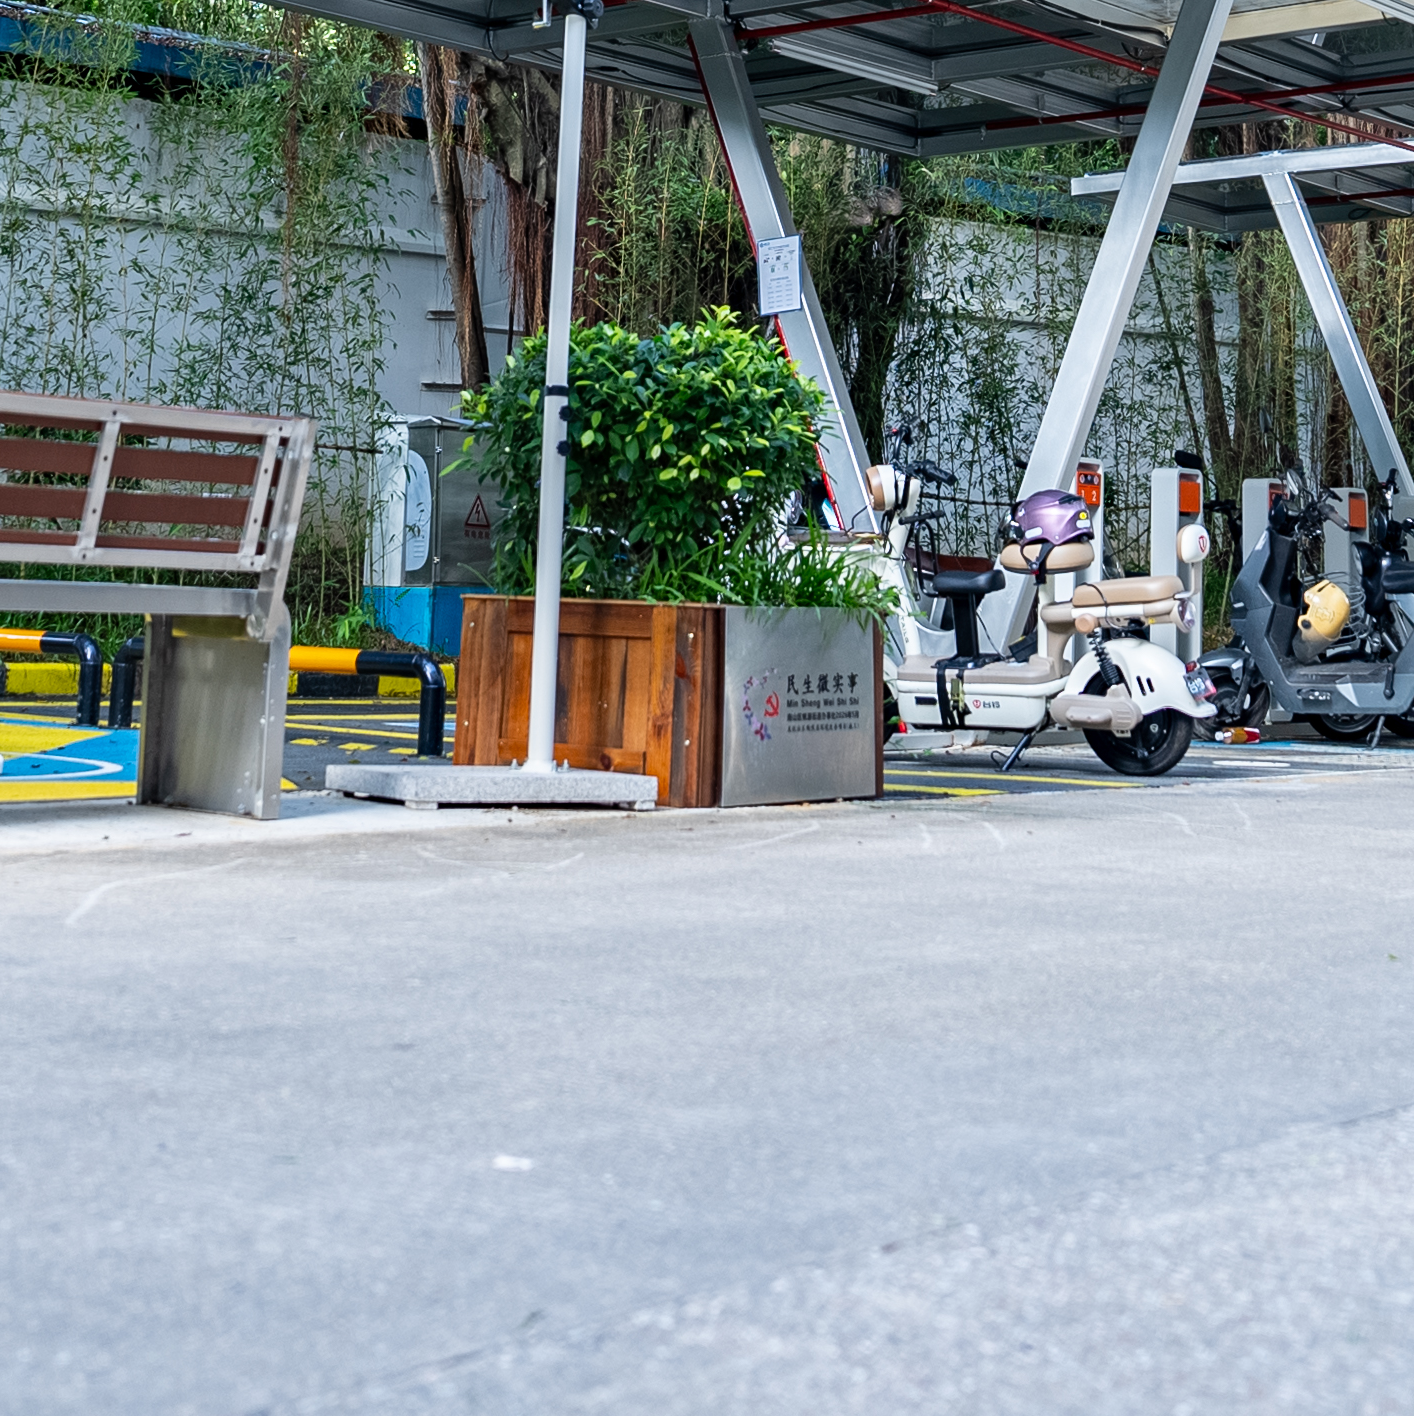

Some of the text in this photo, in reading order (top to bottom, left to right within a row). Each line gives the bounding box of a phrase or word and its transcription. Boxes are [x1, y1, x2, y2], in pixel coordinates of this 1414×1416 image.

[787, 672, 858, 695] 民生微实事
[787, 699, 798, 708] Min
[801, 698, 820, 709] Sheng
[837, 696, 847, 706] Shi
[849, 696, 859, 705] Shi
